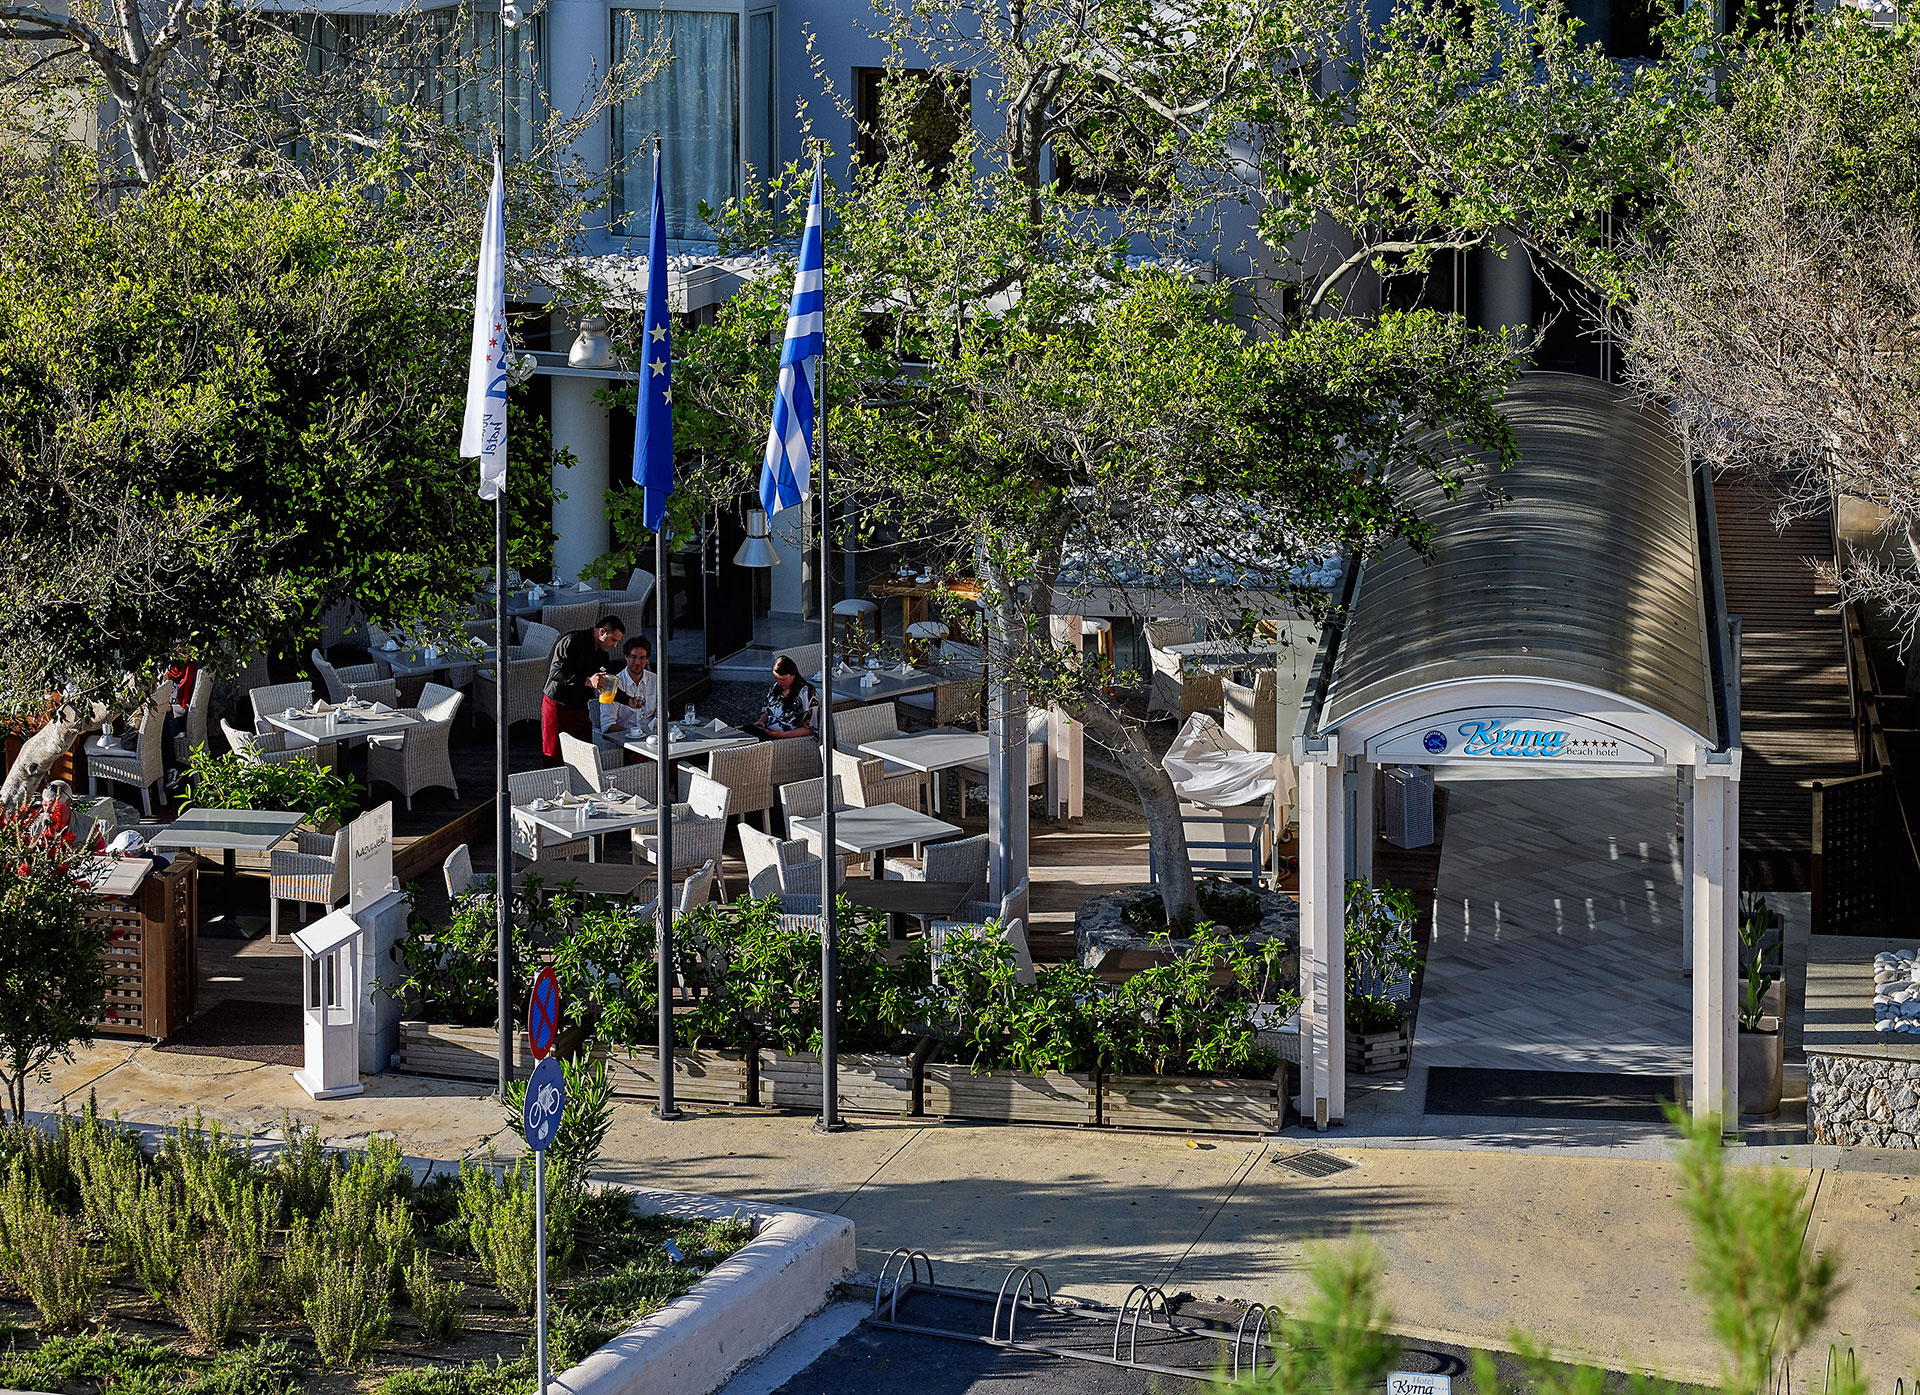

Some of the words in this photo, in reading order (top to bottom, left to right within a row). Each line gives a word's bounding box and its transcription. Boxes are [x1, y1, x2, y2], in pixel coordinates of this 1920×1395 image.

[1458, 720, 1567, 755] Kyma
[1566, 747, 1593, 756] beach
[1596, 748, 1618, 757] hotel
[1392, 1379, 1435, 1395] Kyma
[1412, 1376, 1434, 1385] Hotel
